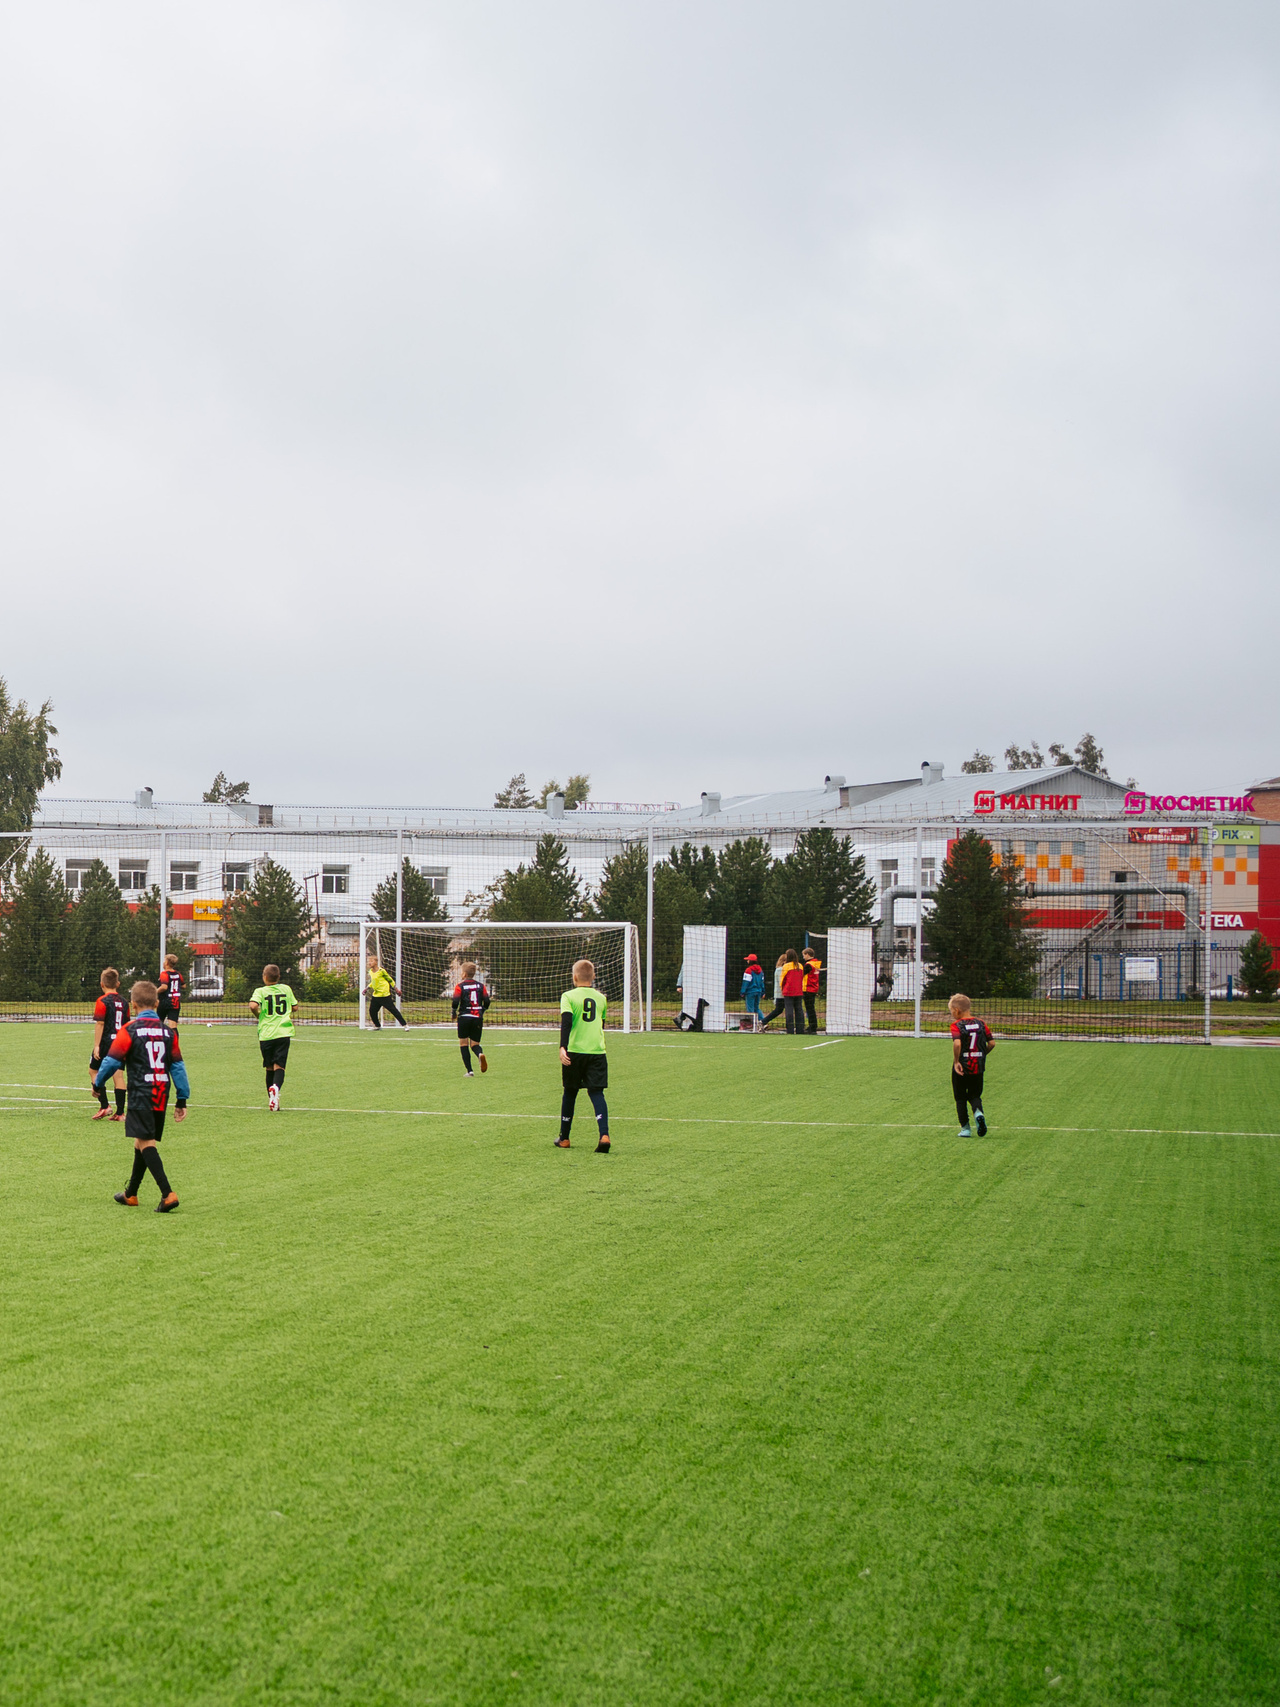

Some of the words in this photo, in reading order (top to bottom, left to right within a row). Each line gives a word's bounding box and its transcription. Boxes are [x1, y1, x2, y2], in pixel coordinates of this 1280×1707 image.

[1000, 794, 1082, 811] МАГНИТ
[1150, 795, 1256, 812] КОСМЕТИК
[1222, 829, 1239, 840] FIX
[1183, 914, 1244, 928] ЕКА
[264, 993, 287, 1016] 15
[470, 990, 478, 1005] 4
[582, 997, 597, 1023] 9
[115, 1010, 122, 1030] 9
[145, 1041, 166, 1069] 12
